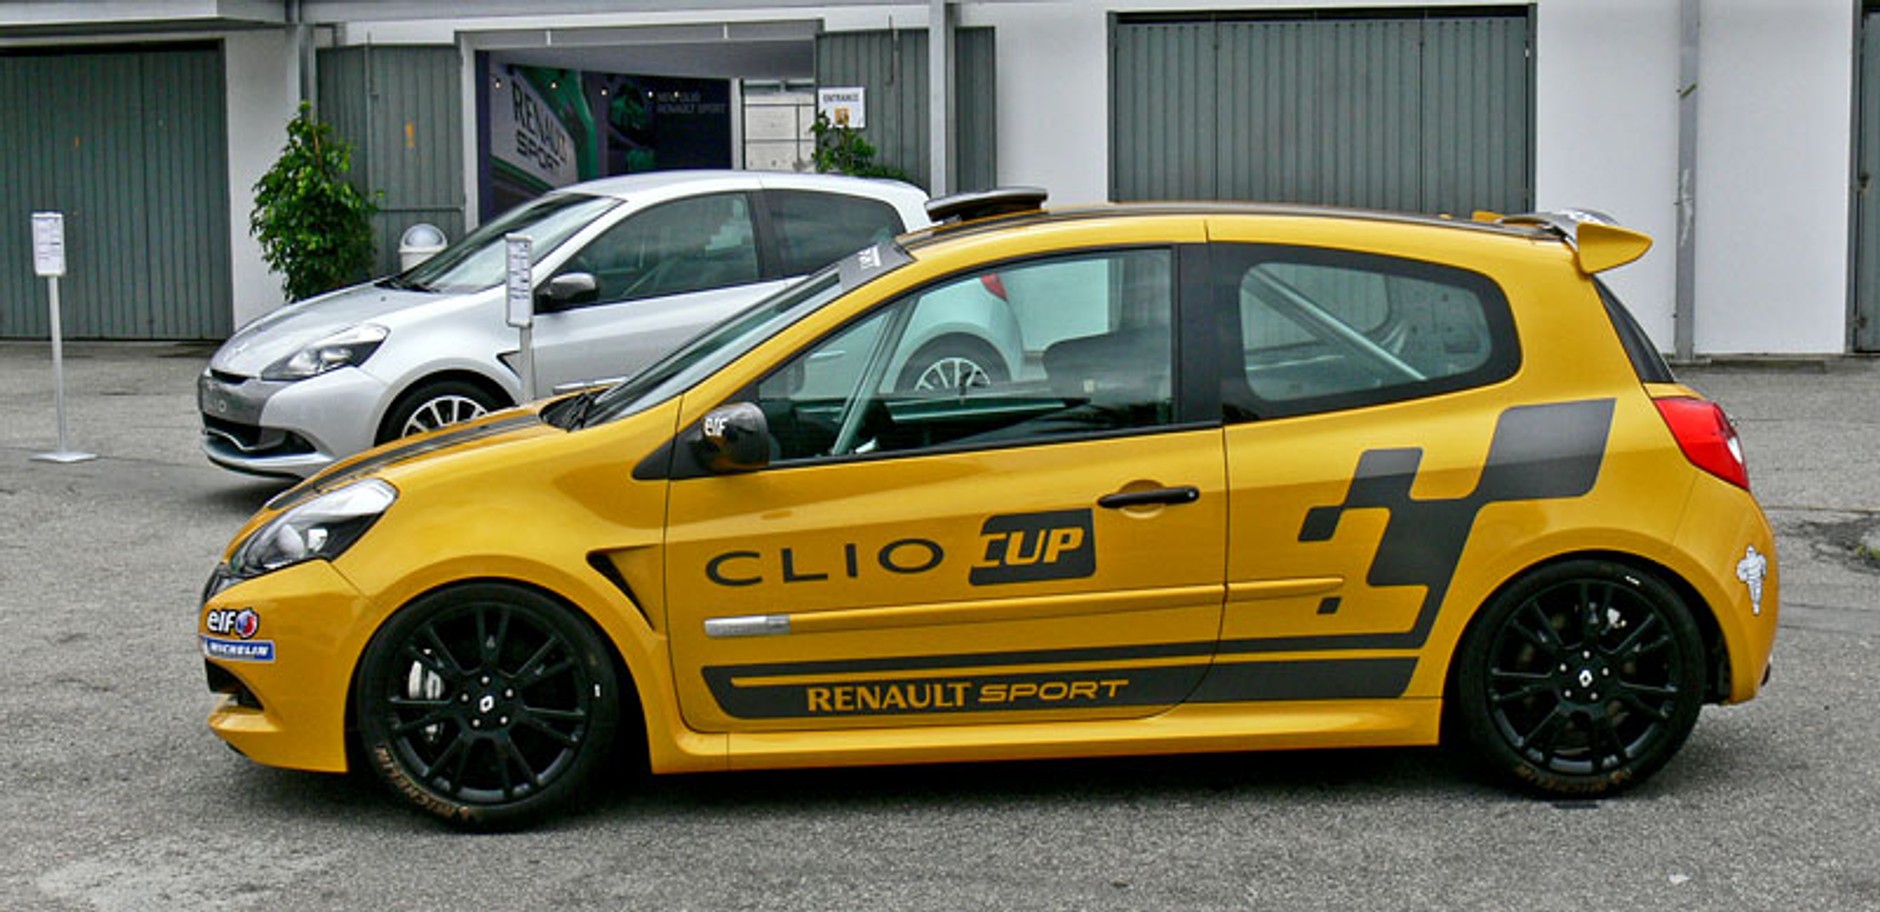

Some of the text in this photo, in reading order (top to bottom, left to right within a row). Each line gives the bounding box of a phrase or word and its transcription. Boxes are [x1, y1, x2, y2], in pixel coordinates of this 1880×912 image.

[822, 93, 859, 103] ENTRANCE
[511, 80, 568, 164] RENAULT
[516, 129, 561, 169] SPORT
[705, 526, 1085, 587] CLIO CUP
[206, 610, 237, 633] elf
[209, 642, 270, 656] MICHELIN
[807, 679, 1130, 712] RENAULT SPORT
